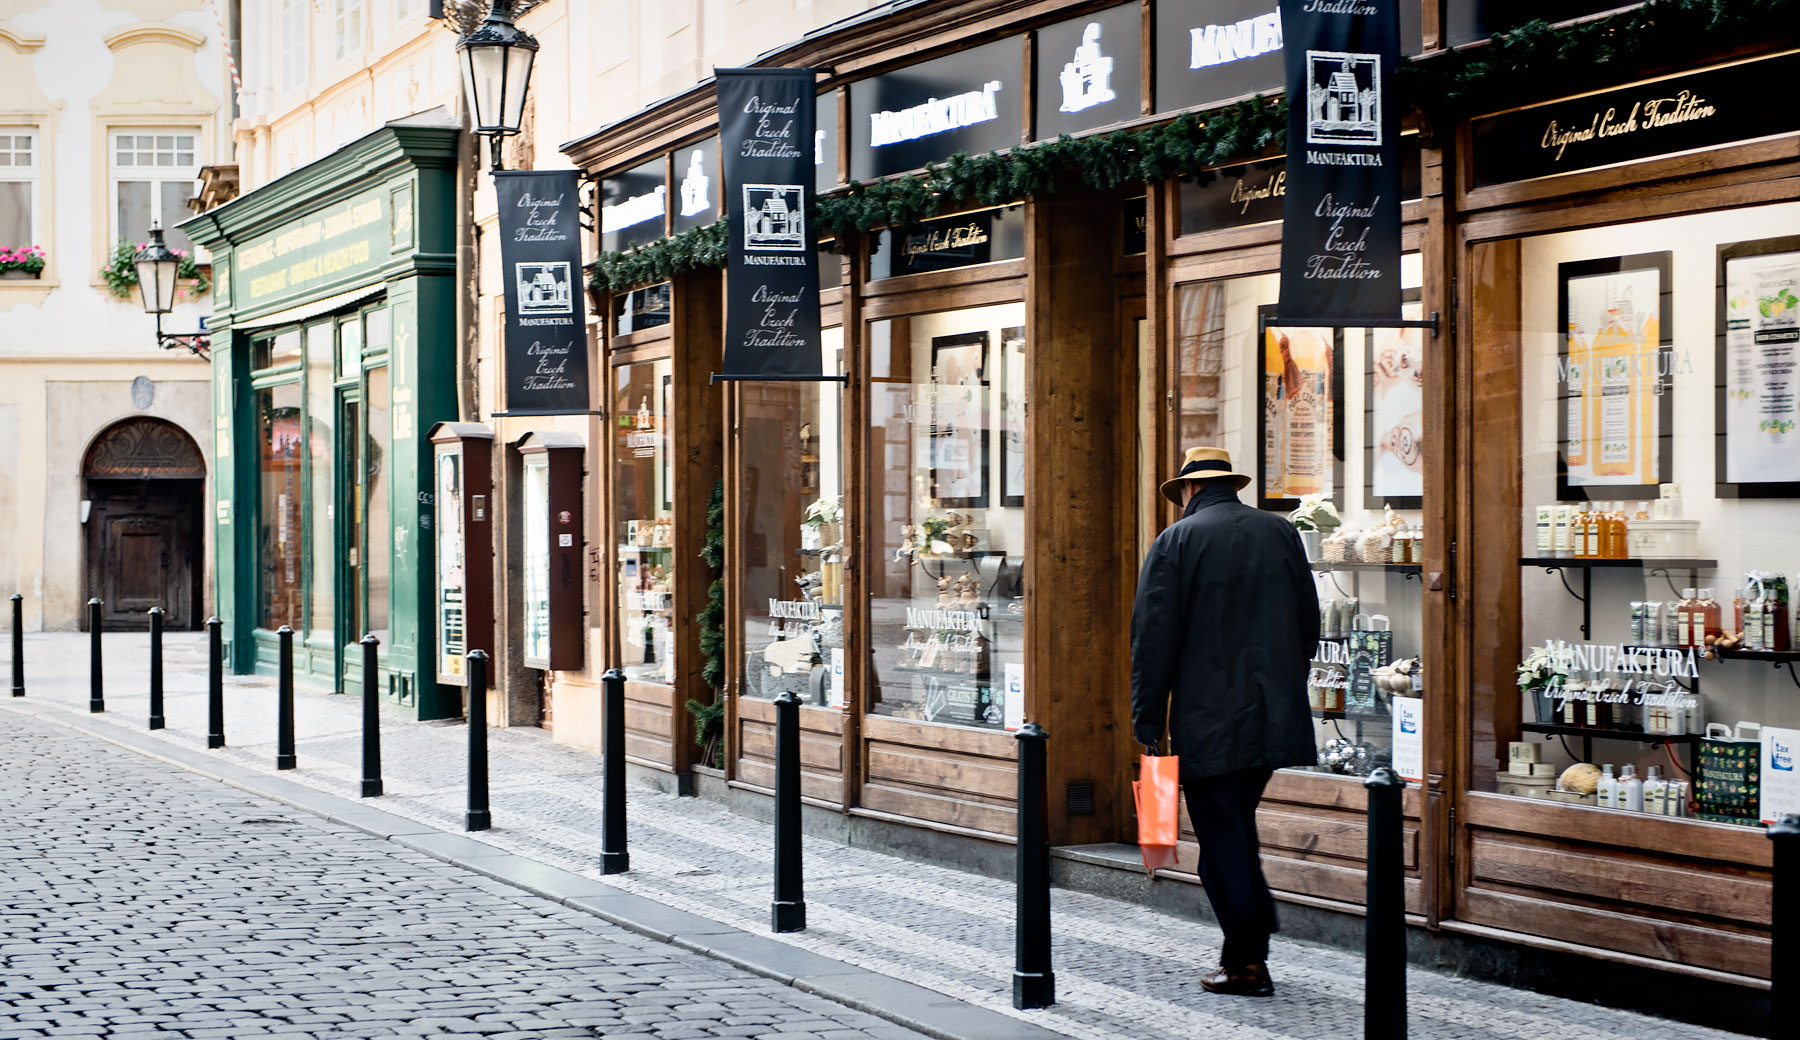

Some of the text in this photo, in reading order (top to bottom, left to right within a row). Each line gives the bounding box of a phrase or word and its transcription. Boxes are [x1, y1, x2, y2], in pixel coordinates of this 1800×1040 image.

[1303, 0, 1378, 16] Tradition
[1190, 6, 1284, 69] MANUFA
[743, 95, 801, 123] Original
[755, 119, 794, 138] Czech
[1540, 90, 1716, 161] Original Czech Tradition
[740, 138, 802, 158] Tradition
[1306, 150, 1383, 167] MANUFAKTURA
[1273, 170, 1287, 197] Cz
[516, 192, 564, 217] Original
[1314, 193, 1381, 231] Original
[526, 210, 558, 226] Czech
[514, 225, 568, 242] Tradition
[1324, 226, 1371, 251] Czech
[744, 255, 807, 266] MANUFAKTURA
[1303, 252, 1383, 279] Tradition
[751, 284, 805, 313] Original
[760, 308, 798, 327] Czech
[743, 328, 807, 347] Tradition
[527, 341, 574, 364] Original
[535, 356, 566, 374] Czech
[522, 374, 577, 391] Tradition
[1310, 639, 1351, 665] TURA
[1634, 680, 1699, 709] Tradition
